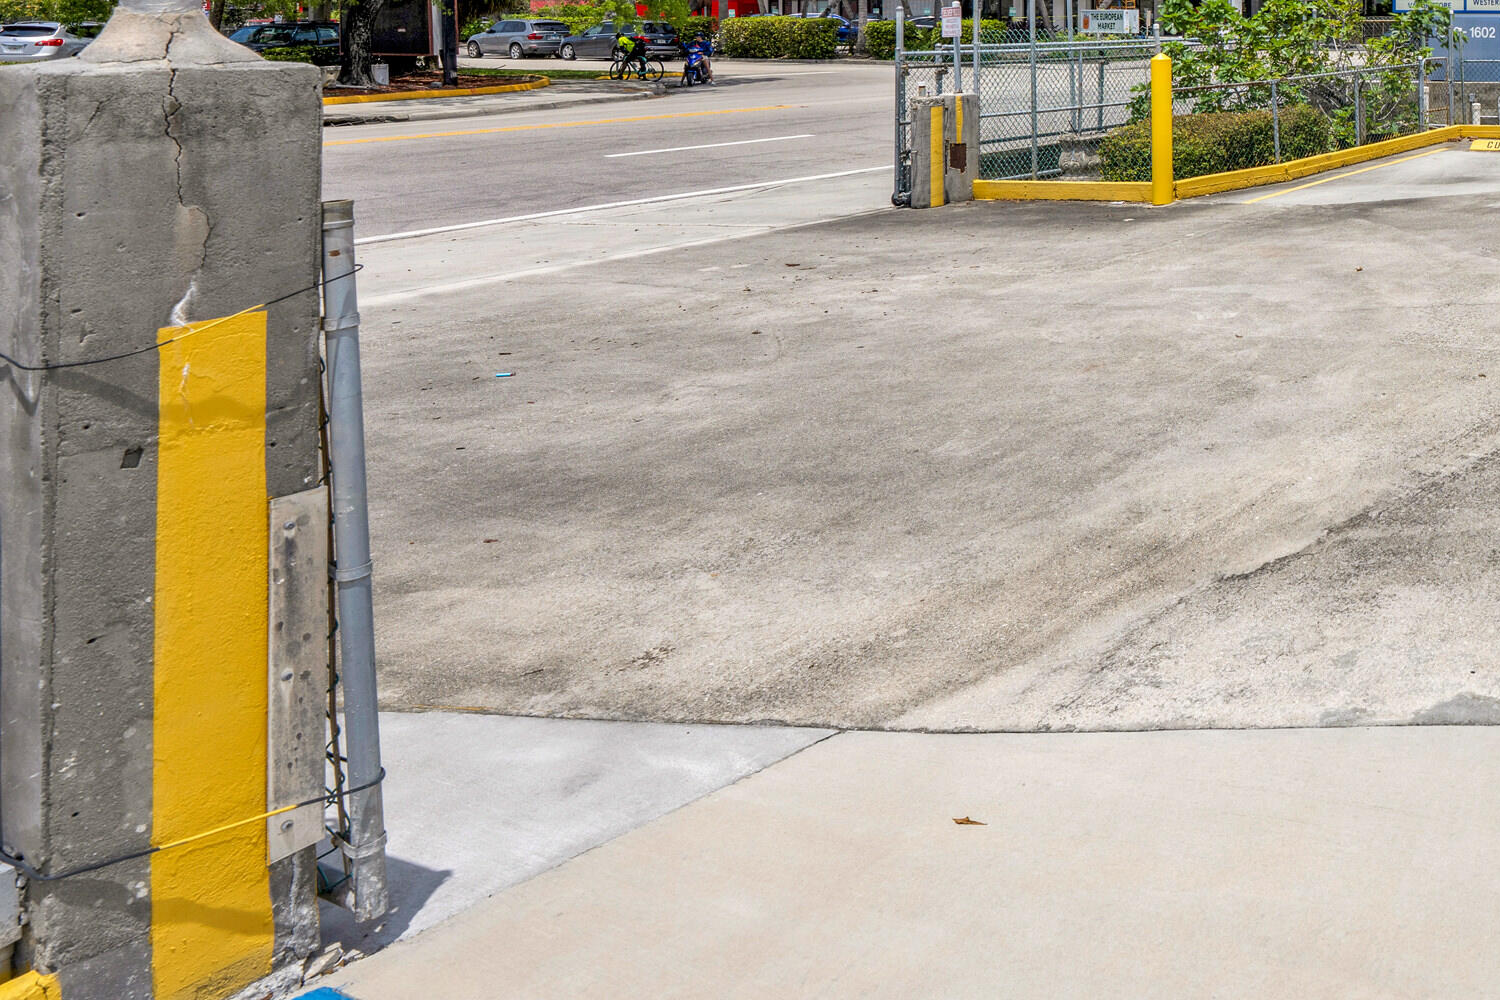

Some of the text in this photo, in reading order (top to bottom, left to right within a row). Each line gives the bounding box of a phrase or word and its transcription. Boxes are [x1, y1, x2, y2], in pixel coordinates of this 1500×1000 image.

[1091, 12, 1123, 21] THE EUROPEAN
[1098, 22, 1116, 30] MARKET
[1470, 26, 1496, 38] 1602
